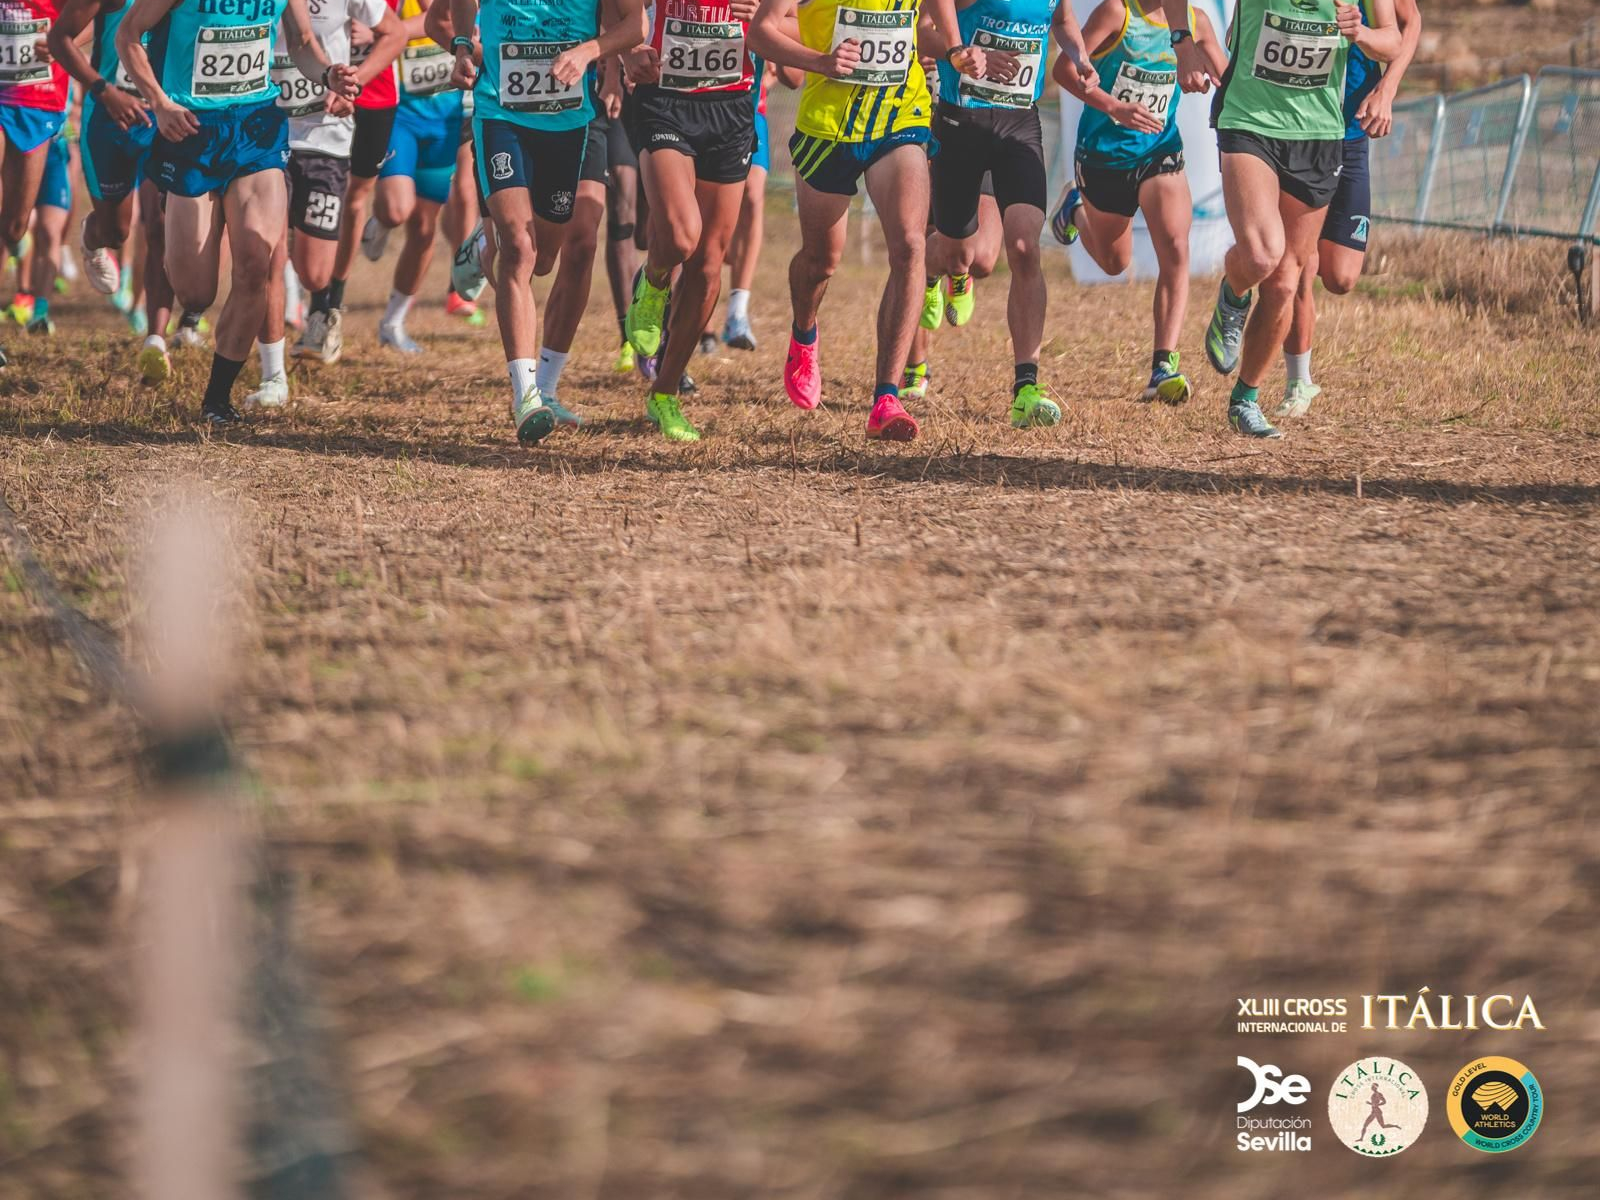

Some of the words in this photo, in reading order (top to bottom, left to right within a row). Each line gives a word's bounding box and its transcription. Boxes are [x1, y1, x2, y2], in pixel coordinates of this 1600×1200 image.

[665, 0, 738, 23] CURTIU
[201, 50, 265, 77] 8204
[668, 47, 737, 71] 8166
[857, 39, 907, 64] 058
[1263, 40, 1332, 69] 6057
[411, 60, 455, 85] 609
[304, 191, 340, 230] 23
